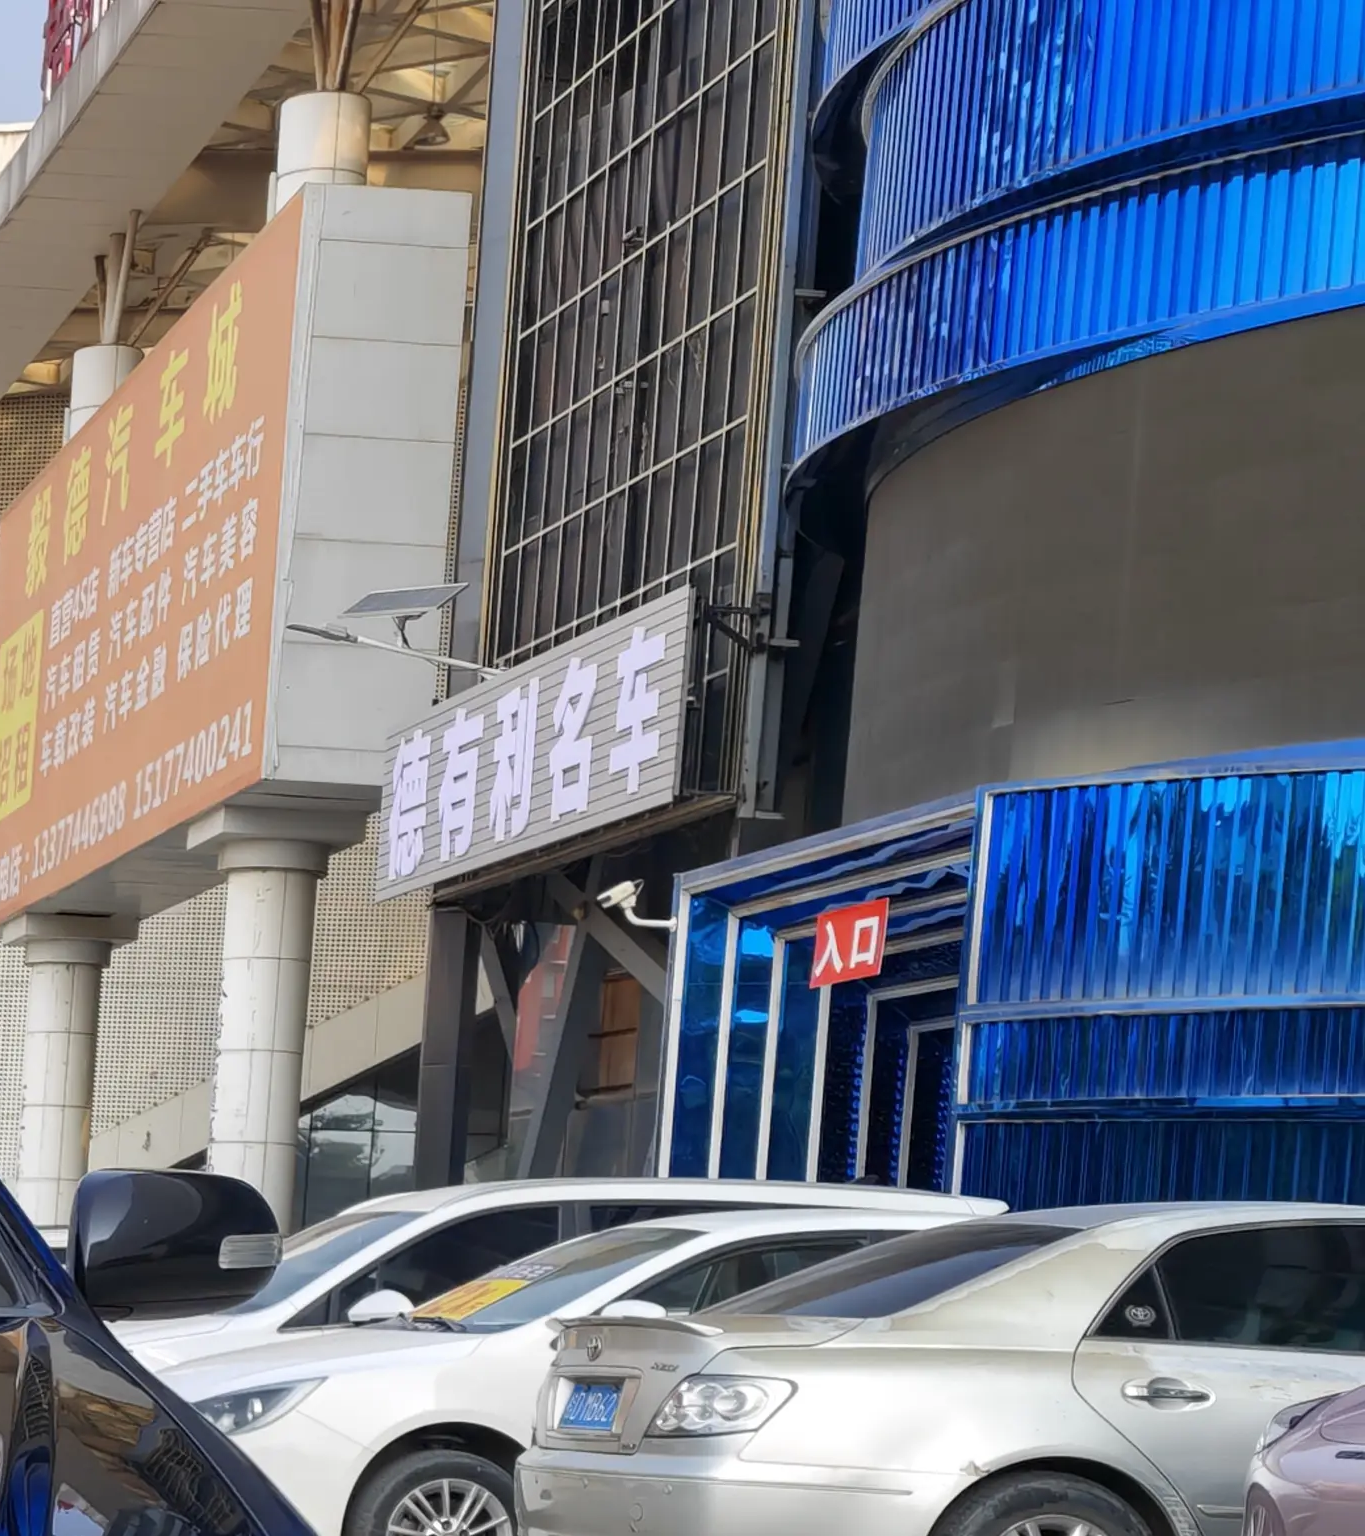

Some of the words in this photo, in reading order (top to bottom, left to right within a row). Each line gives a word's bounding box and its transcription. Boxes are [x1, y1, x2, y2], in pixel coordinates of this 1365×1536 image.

[24, 280, 243, 599] 毅德汽车城
[48, 565, 100, 650] 直营4S店
[107, 496, 178, 600] 新车专营店
[181, 414, 266, 532] 二手车车行
[1, 620, 38, 714] 场地
[44, 627, 101, 714] 汽车租赁
[107, 566, 172, 665] 汽车配件
[181, 497, 259, 606] 汽车美容
[103, 640, 167, 735] 汽车金融
[176, 576, 253, 683] 保险代理
[133, 699, 253, 820] 15177400241
[387, 626, 666, 881] 德有利名车
[814, 915, 881, 977] 入口
